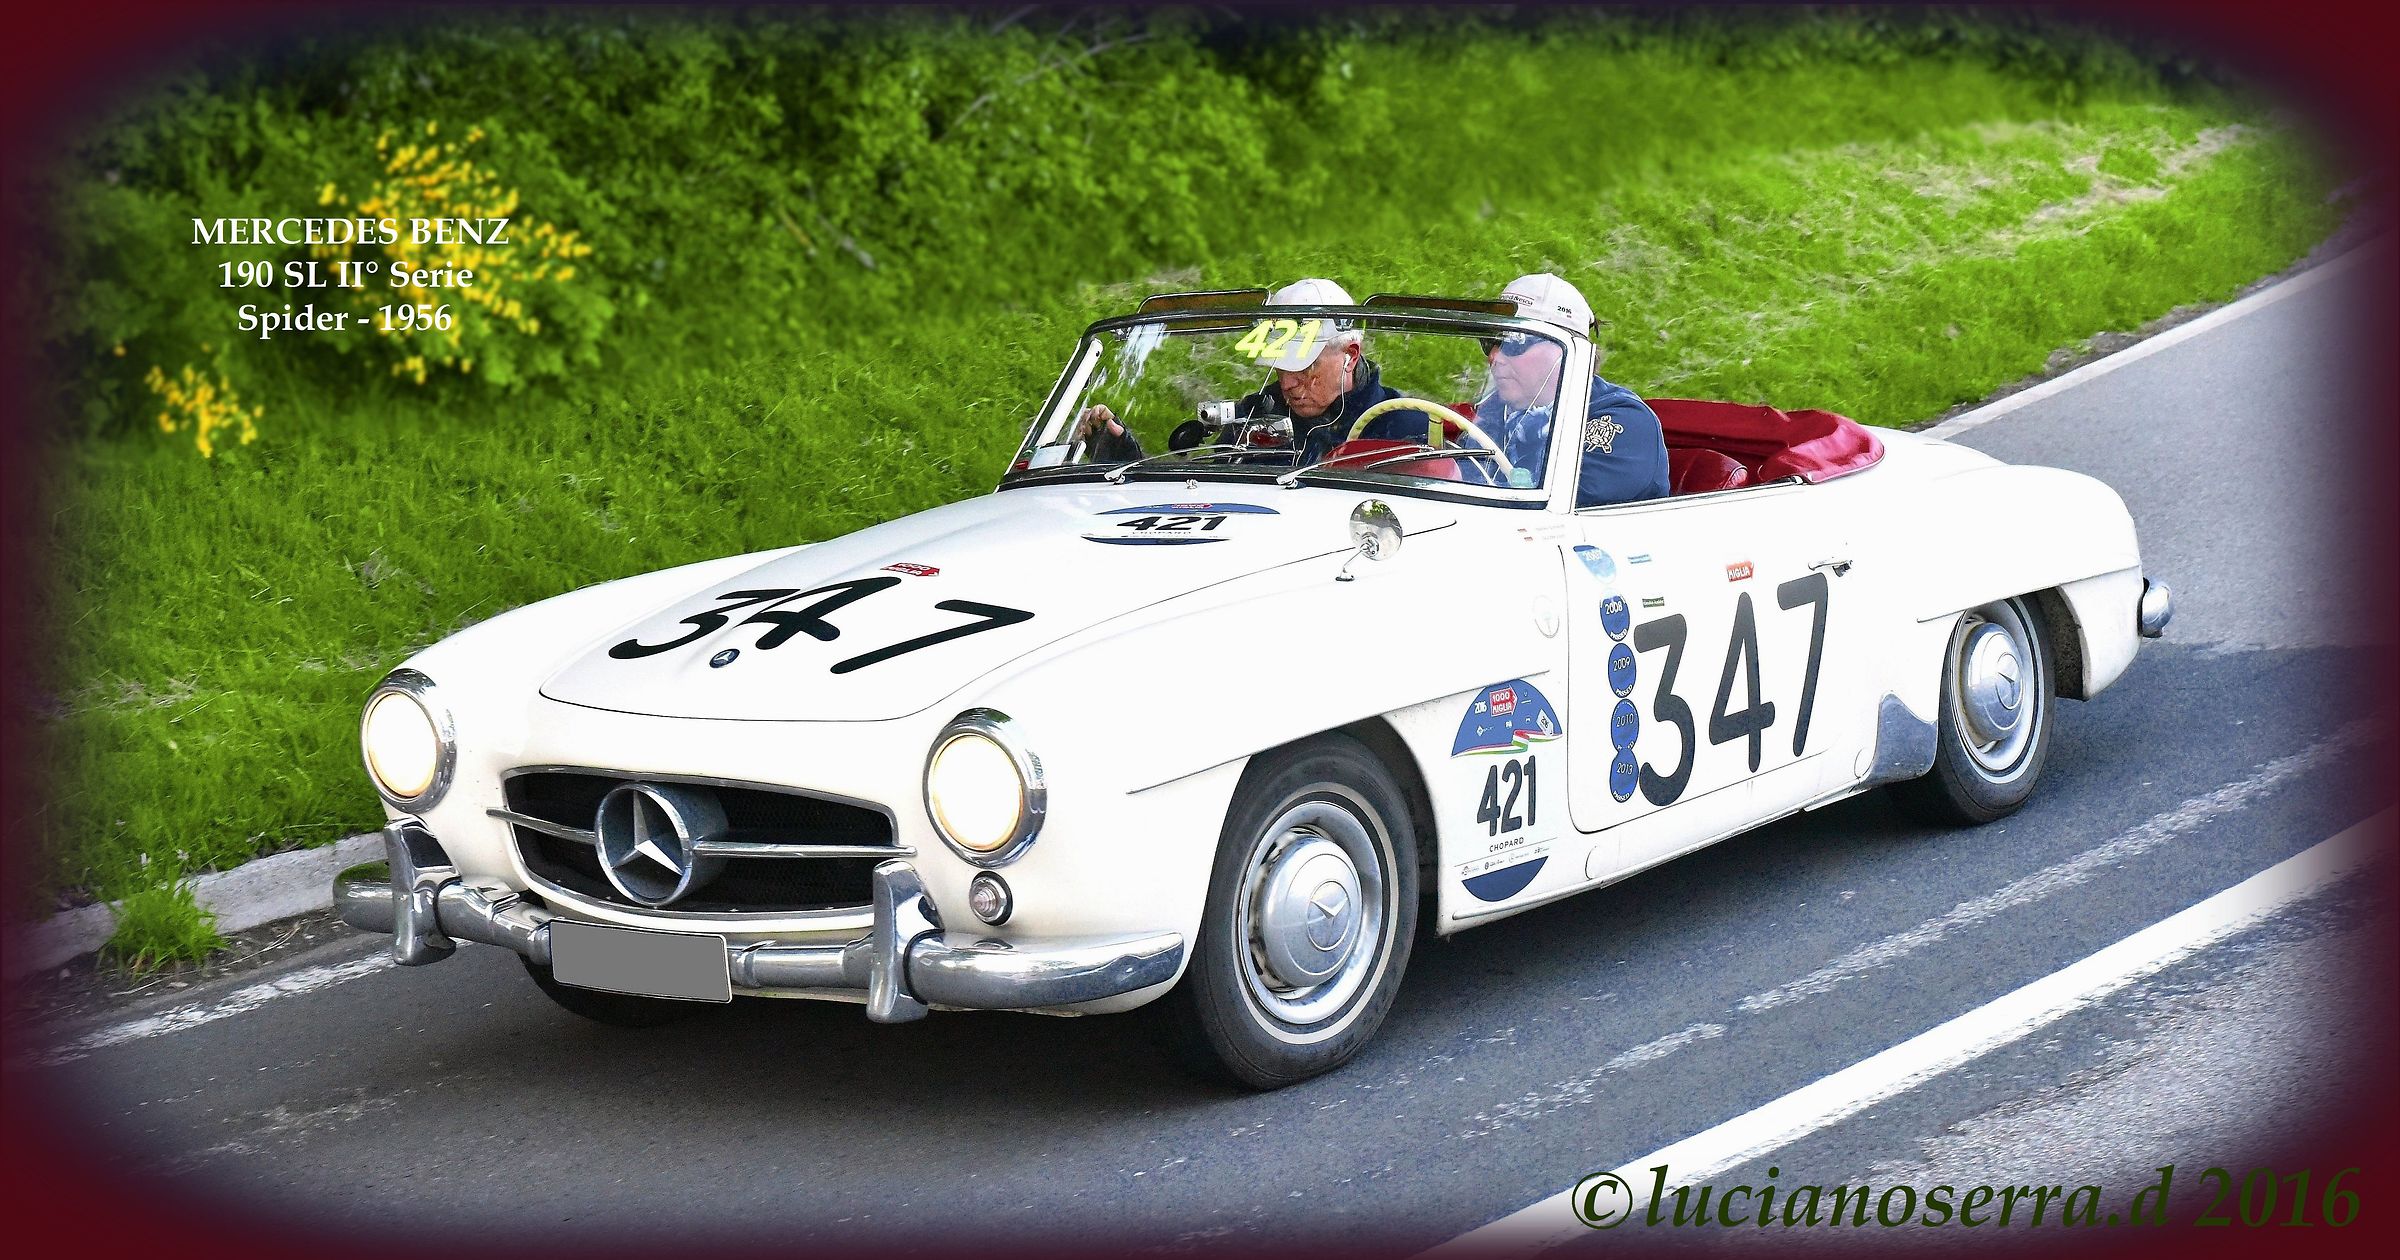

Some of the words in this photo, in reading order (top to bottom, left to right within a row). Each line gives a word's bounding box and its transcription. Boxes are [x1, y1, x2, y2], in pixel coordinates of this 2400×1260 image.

[1235, 319, 1321, 359] 421
[1117, 516, 1228, 531] 421
[1605, 601, 1623, 615] 2008
[609, 577, 1035, 674] 347
[1613, 657, 1631, 672] 2009
[1492, 691, 1511, 703] 1000
[1634, 572, 1828, 807] 347
[1474, 701, 1488, 714] 2016
[1491, 702, 1512, 715] MIGLIA
[1616, 713, 1634, 728] 2010
[1616, 763, 1634, 775] 2013
[1477, 755, 1536, 836] 421
[1489, 836, 1524, 853] CHOPARD
